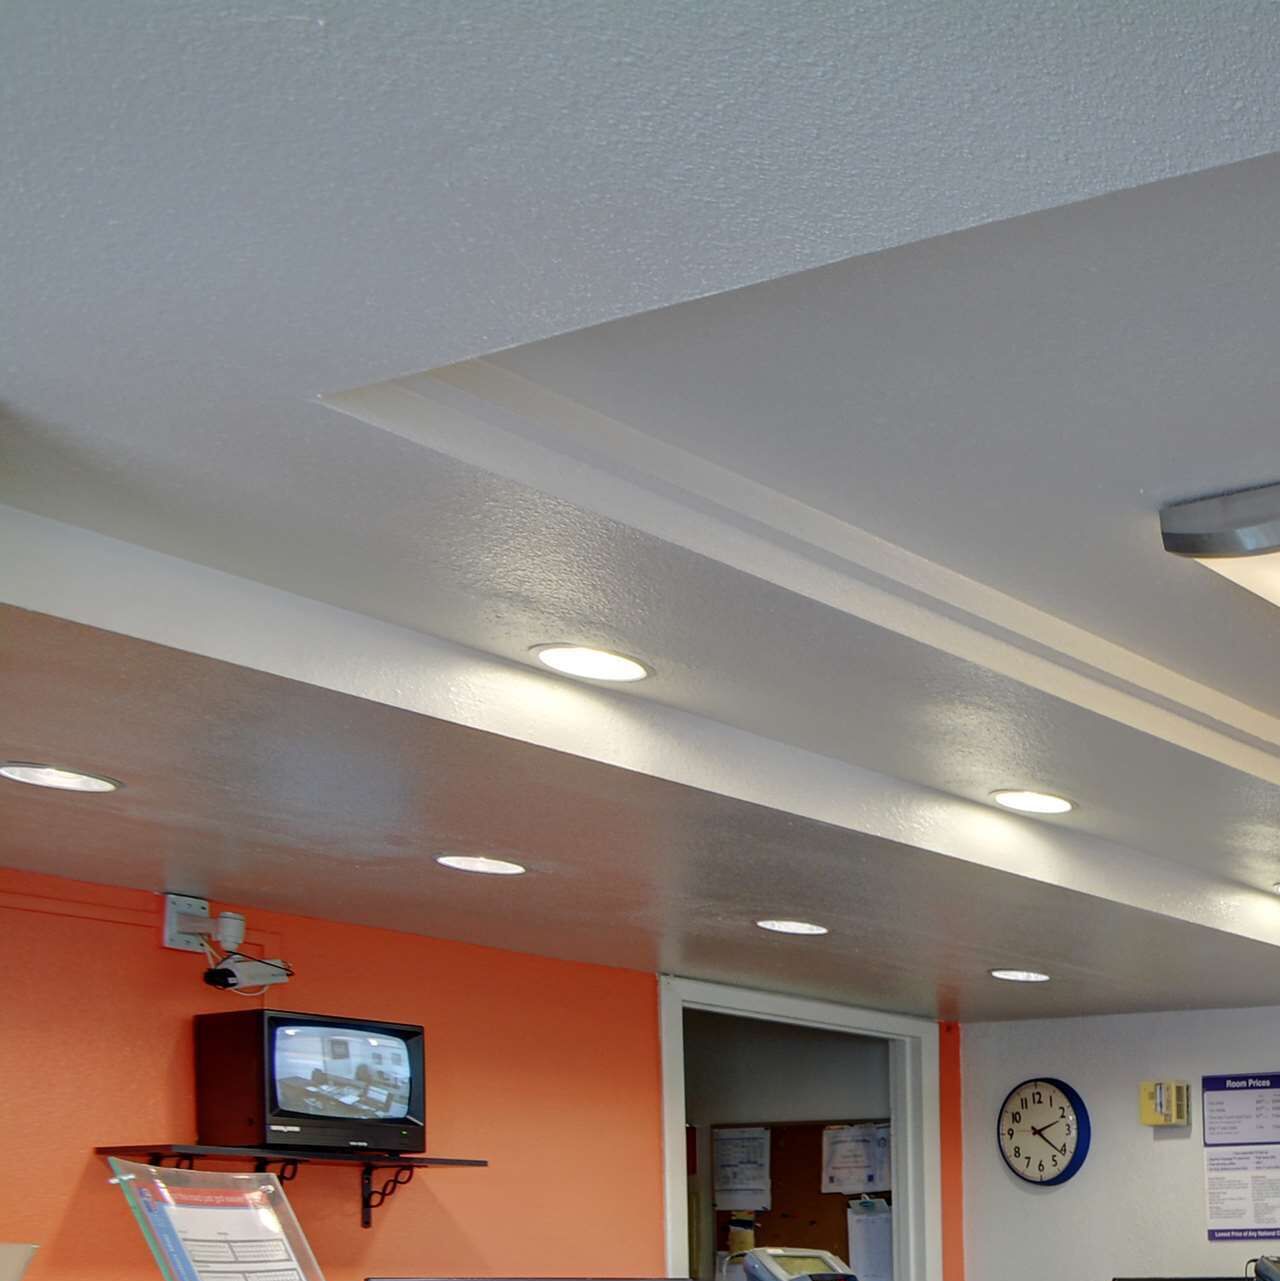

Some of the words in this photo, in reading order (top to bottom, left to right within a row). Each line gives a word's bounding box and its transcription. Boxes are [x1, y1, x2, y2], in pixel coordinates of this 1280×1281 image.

[1225, 1080, 1247, 1088] Room
[1248, 1079, 1271, 1087] Prices
[1020, 1098, 1028, 1110] 11
[1032, 1092, 1043, 1105] 12
[1011, 1112, 1022, 1124] 10
[1059, 1107, 1066, 1118] 2
[1007, 1128, 1014, 1140] 9
[1065, 1124, 1072, 1136] 3
[1014, 1146, 1021, 1158] 8
[1060, 1143, 1067, 1156] 4
[1025, 1157, 1032, 1168] 7
[1038, 1160, 1045, 1172] 6
[1051, 1155, 1058, 1167] 5
